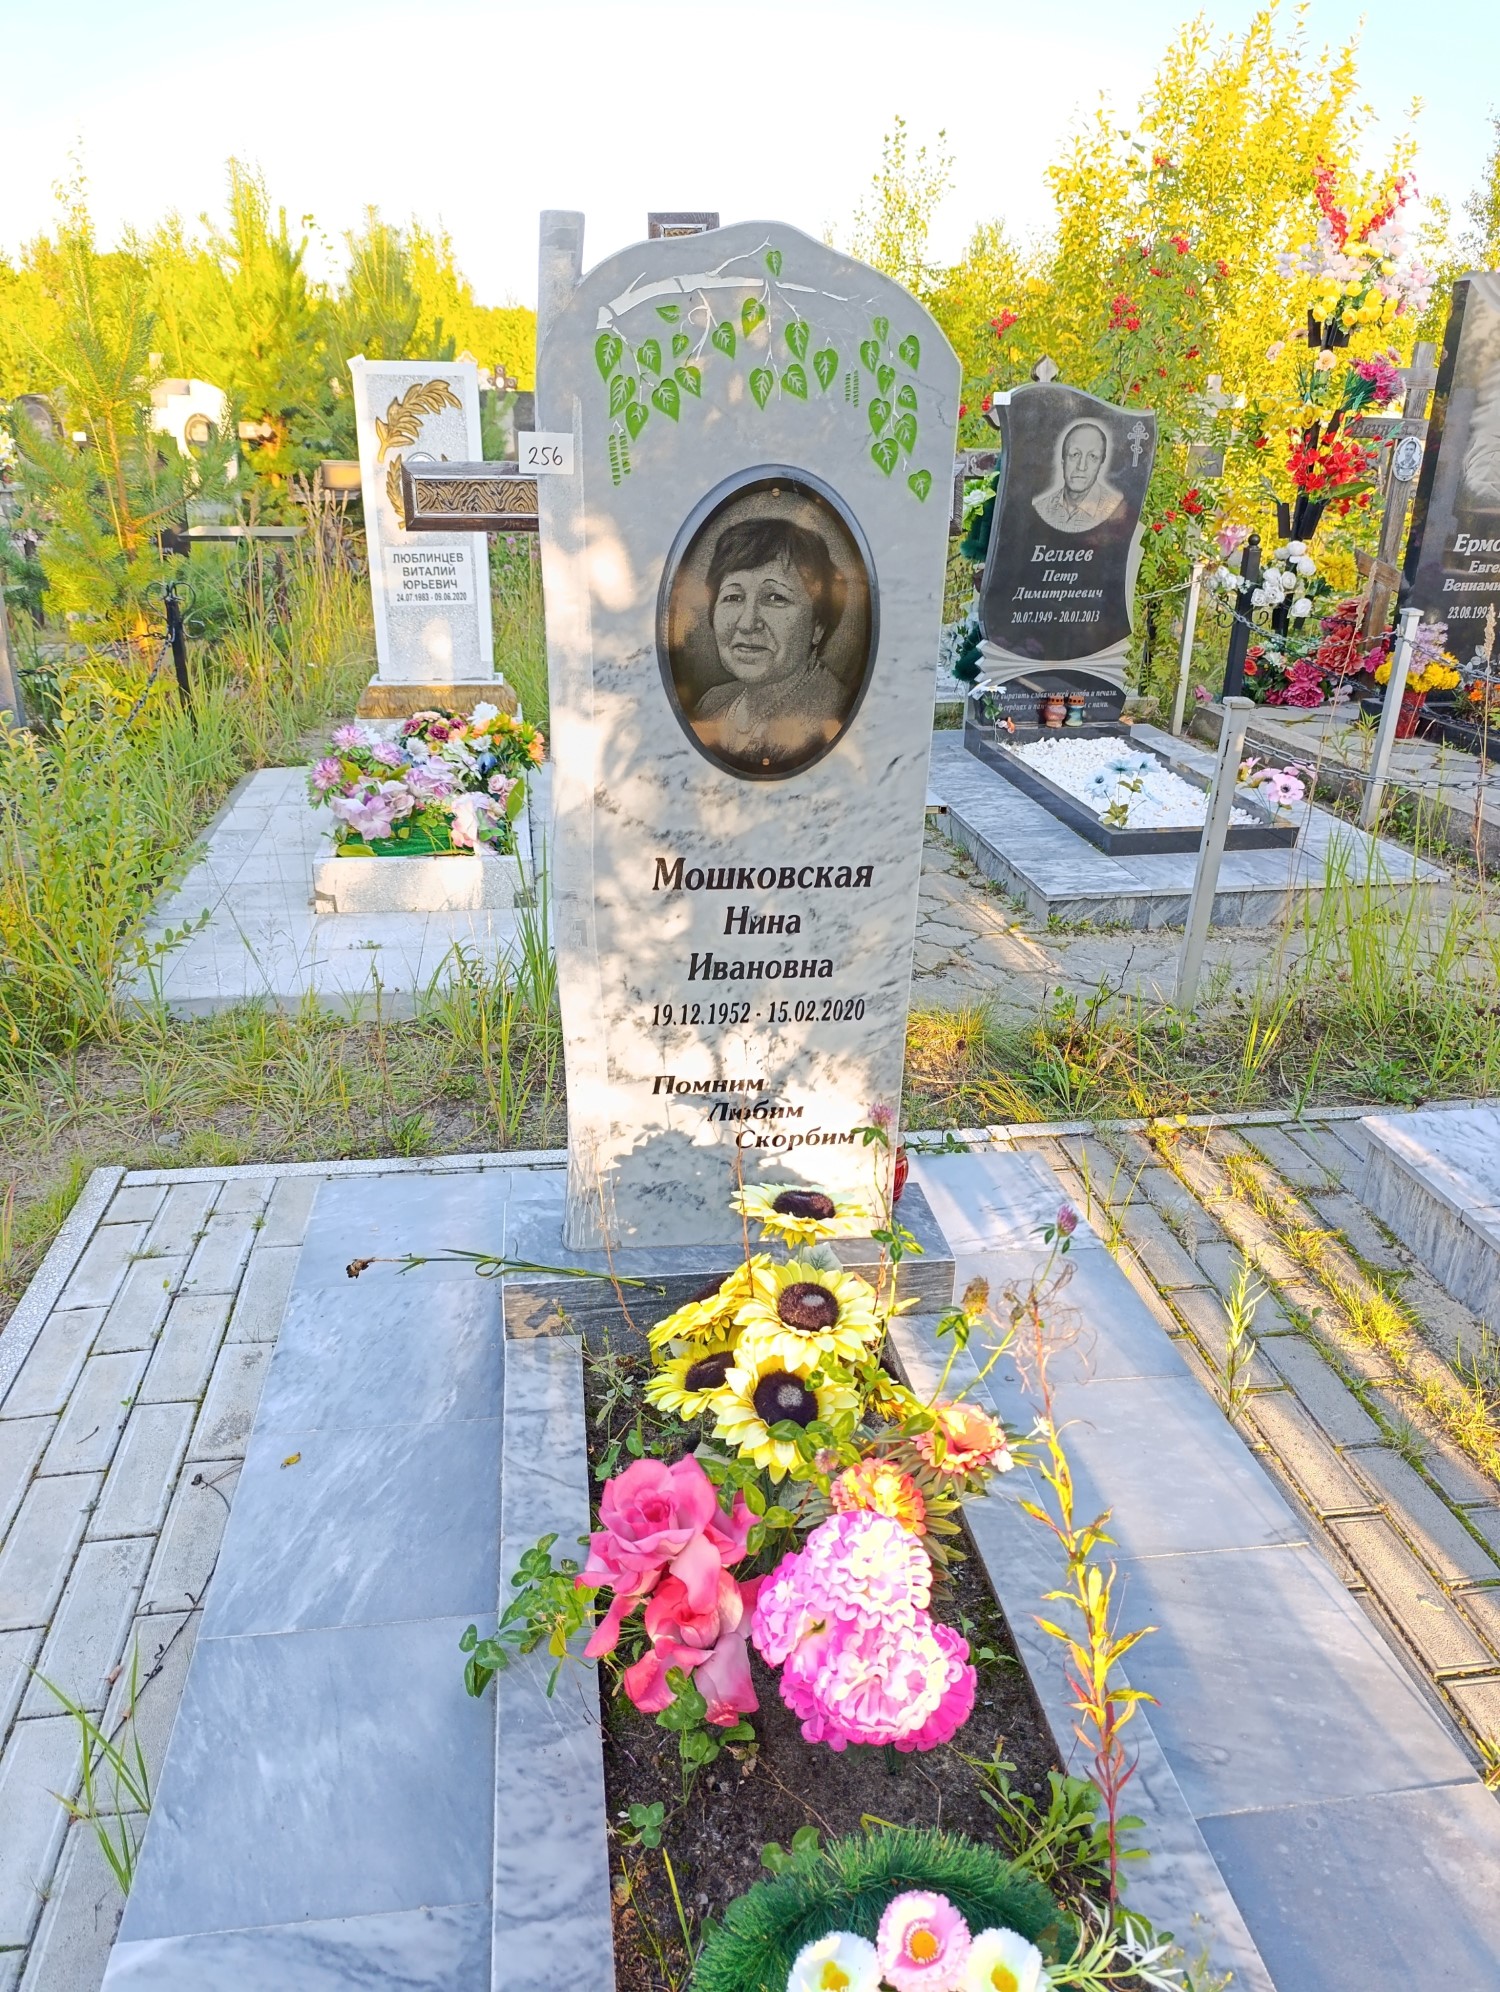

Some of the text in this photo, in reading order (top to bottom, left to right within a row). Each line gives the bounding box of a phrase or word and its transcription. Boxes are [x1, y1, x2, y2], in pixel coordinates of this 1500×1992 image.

[528, 446, 563, 466] 256
[392, 552, 464, 565] ЛЮБЛИНЦЕВ
[1030, 545, 1094, 562] Беляев
[402, 564, 456, 577] ВИТАЛИЙ
[1468, 560, 1500, 574] Евге
[403, 579, 458, 590] ЮРЬЕВИЧ
[1042, 569, 1079, 585] Петр
[1012, 587, 1103, 602] Димитриевич
[1011, 611, 1053, 624] 20.07.1949
[1059, 610, 1100, 623] 20.01.2013
[652, 857, 874, 890] Мошковская
[723, 906, 801, 935] Нина
[687, 952, 834, 981] Ивановна
[652, 1002, 751, 1026] 19.12.1952
[768, 999, 865, 1023] 15.02.2020
[652, 1075, 765, 1095] Помним
[707, 1099, 804, 1122] Любим
[735, 1126, 856, 1151] Скорбим
